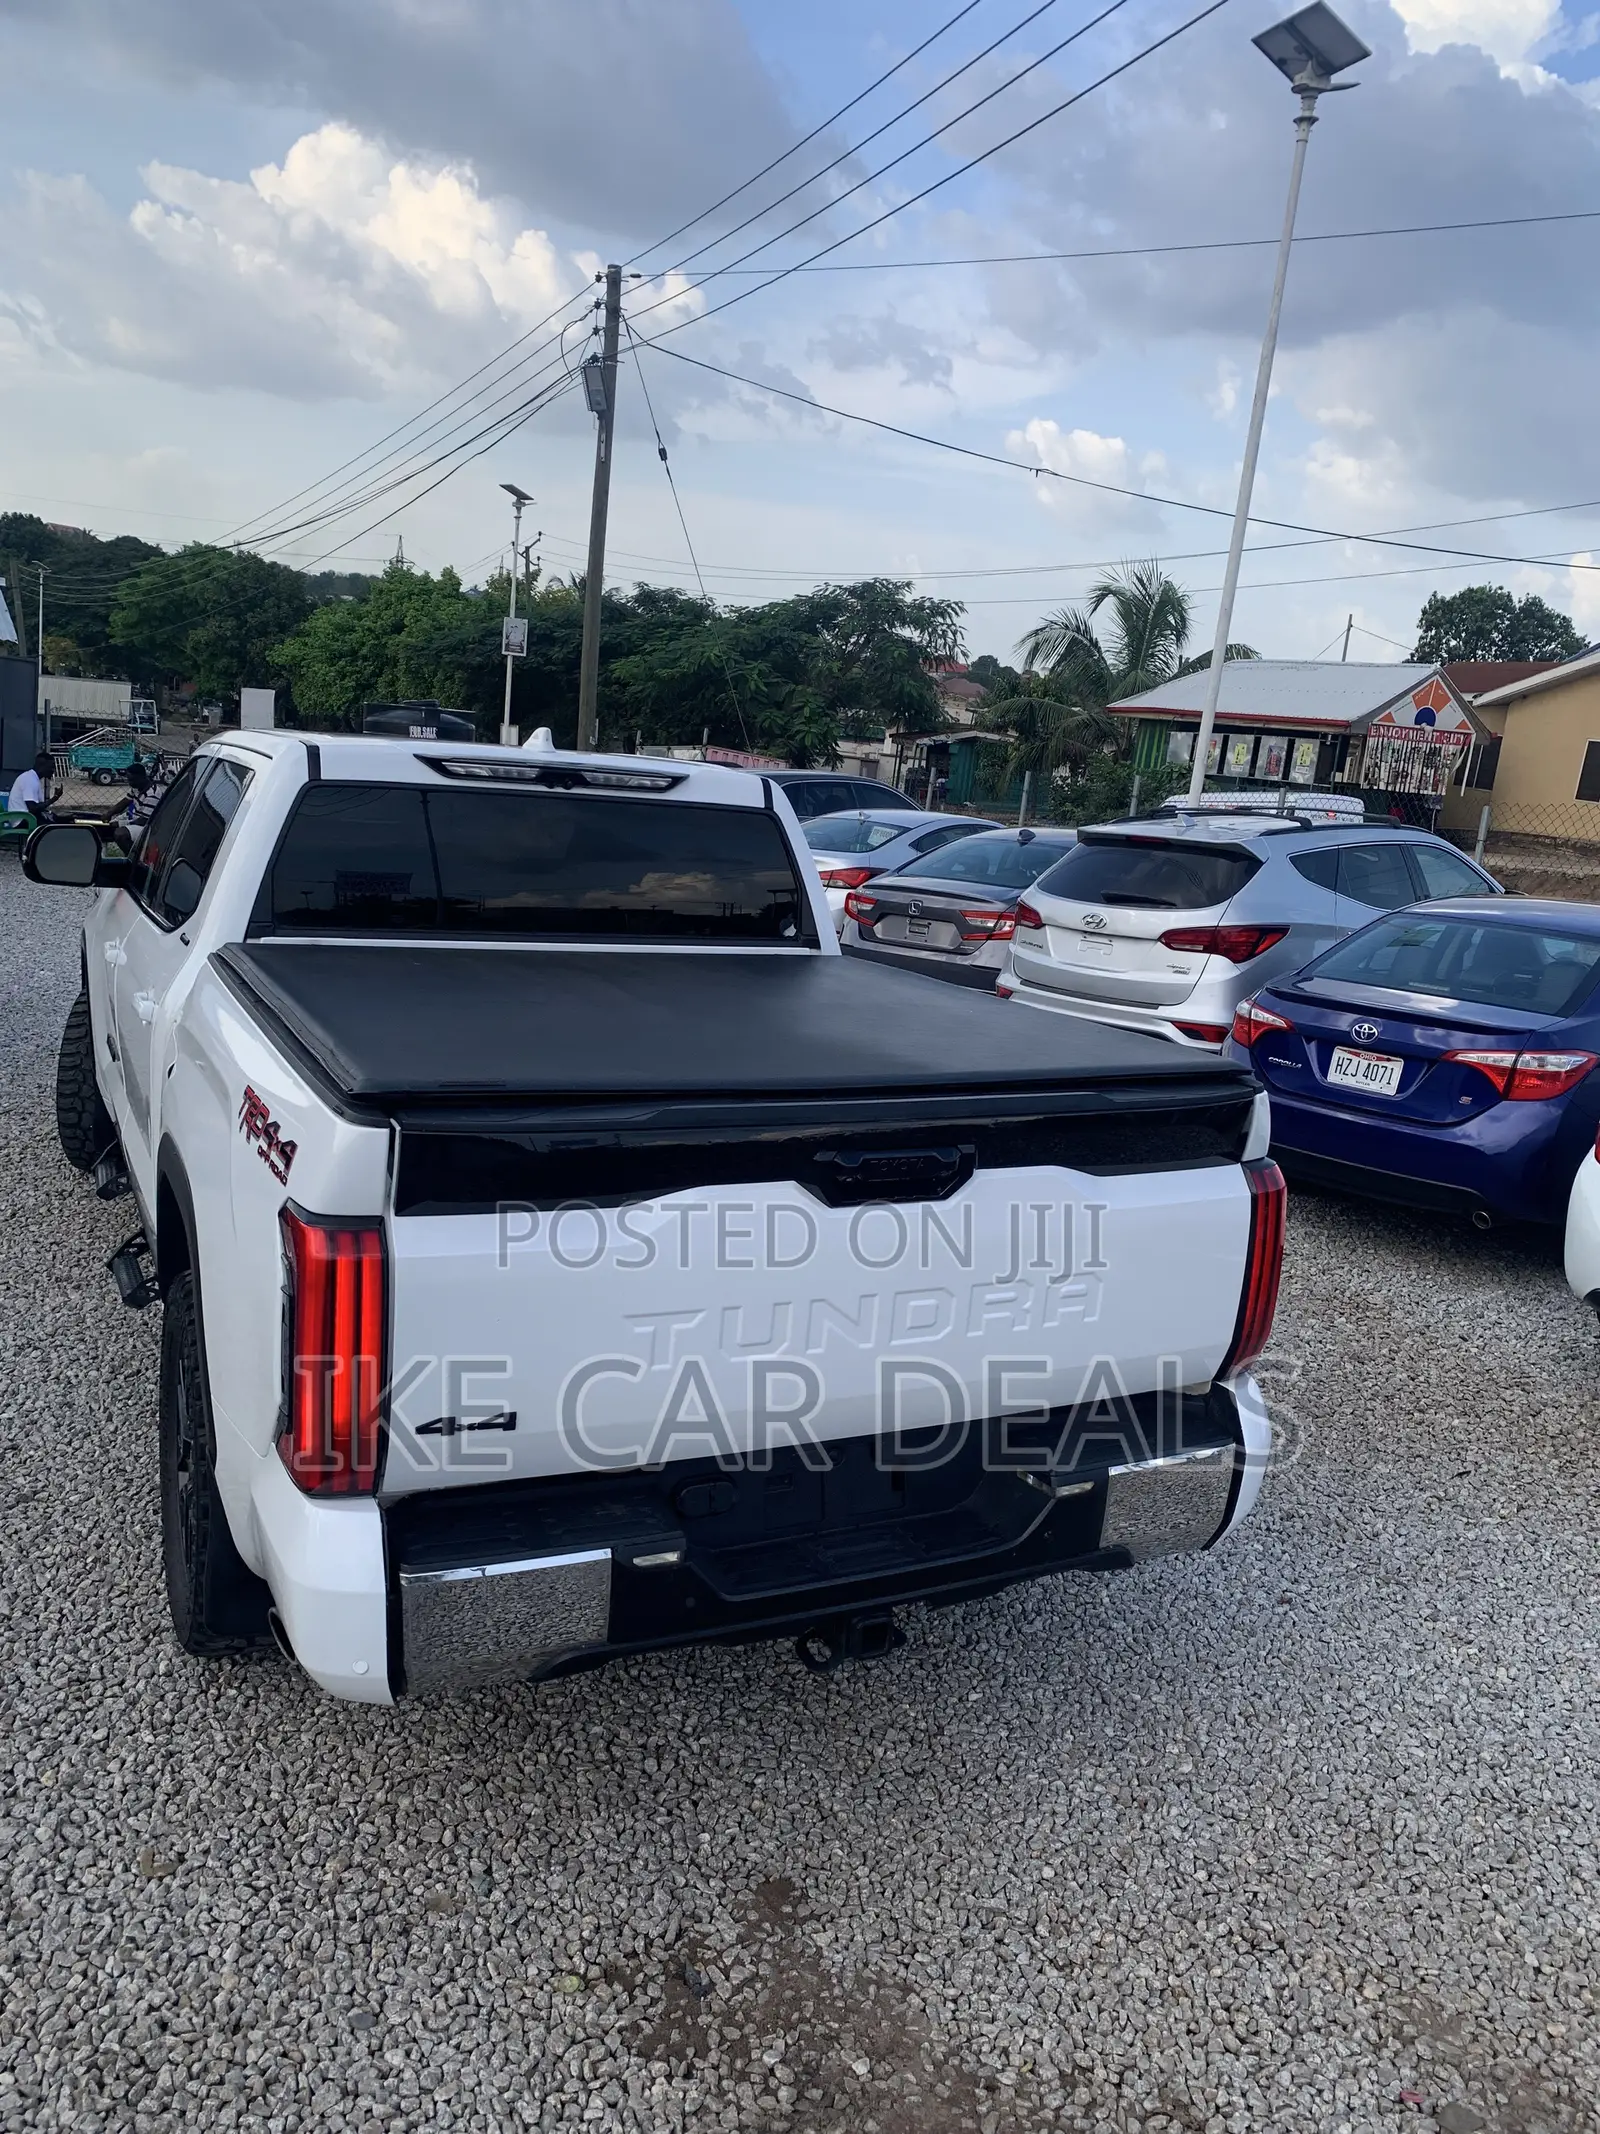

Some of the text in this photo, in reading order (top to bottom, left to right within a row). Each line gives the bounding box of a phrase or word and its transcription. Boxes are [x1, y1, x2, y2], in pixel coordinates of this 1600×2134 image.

[409, 726, 438, 739] FOR SALE
[1370, 725, 1440, 743] ENJOYMENT
[1360, 1053, 1377, 1061] OHIO
[1334, 1055, 1395, 1086] HZJ 4071
[268, 1159, 288, 1187] ROAD
[870, 1157, 925, 1172] TOYOTA
[622, 1271, 1104, 1372] TUNDRA
[414, 1410, 518, 1437] 4x4
